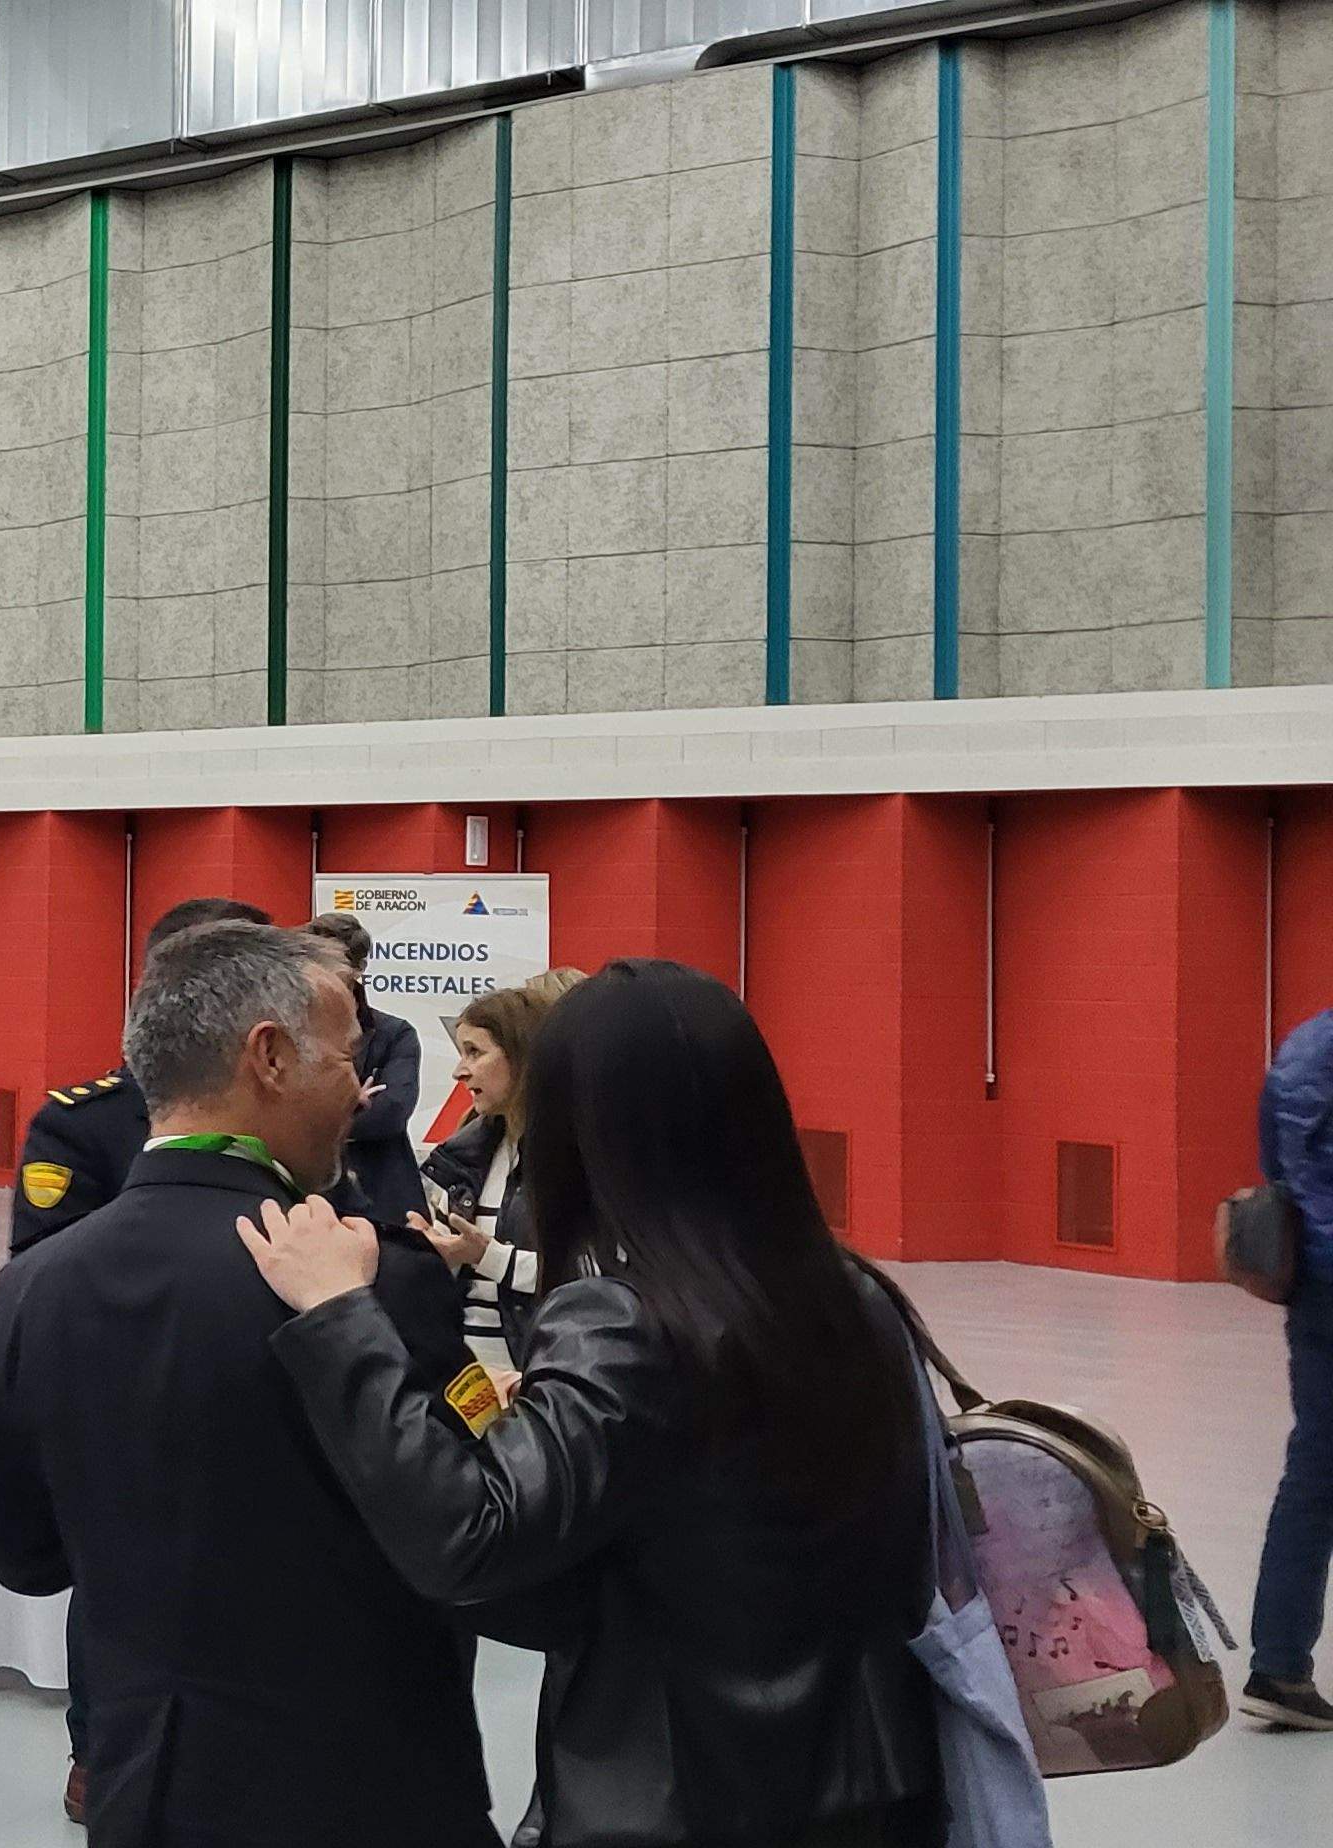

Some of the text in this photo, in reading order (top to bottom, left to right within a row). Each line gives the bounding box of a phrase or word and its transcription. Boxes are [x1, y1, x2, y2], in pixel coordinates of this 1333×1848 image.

[355, 889, 418, 900] GOBIERNO
[355, 901, 427, 911] DE ARAGON
[362, 974, 496, 995] FORESTALES
